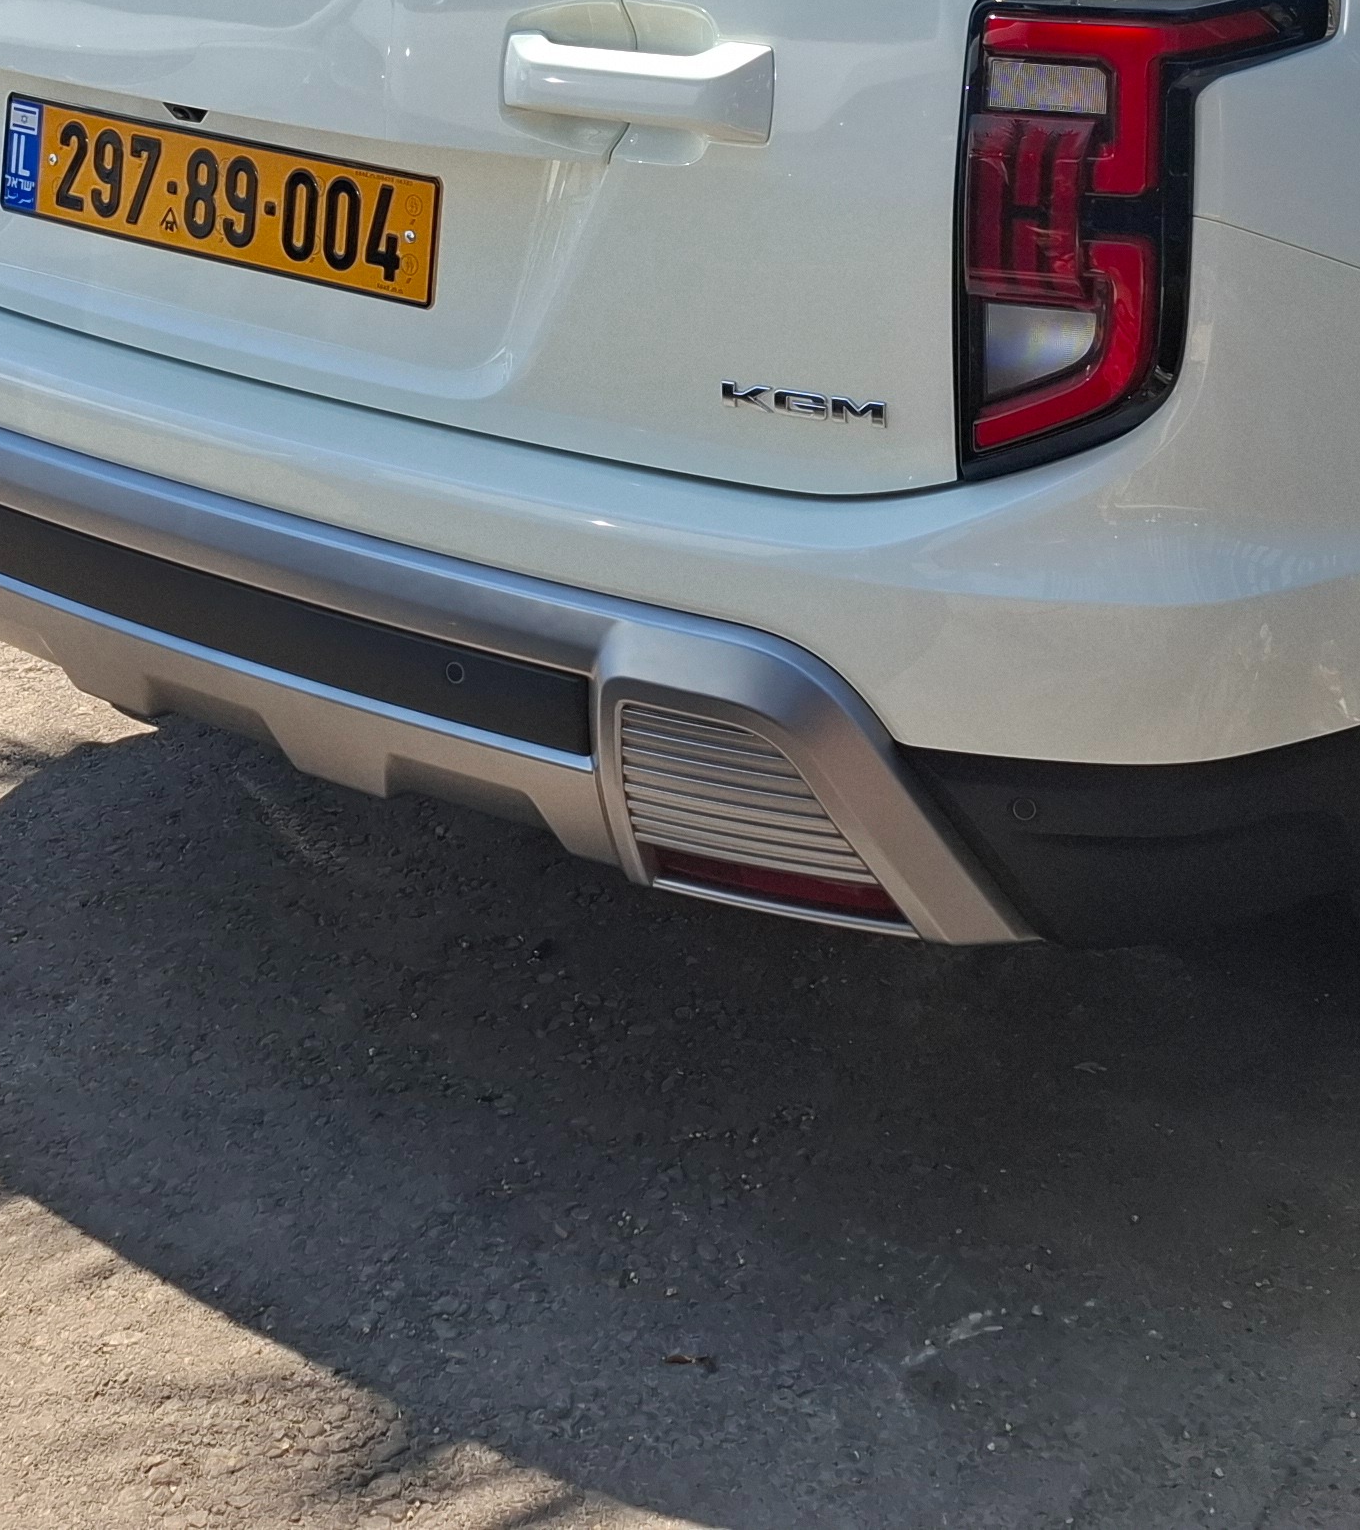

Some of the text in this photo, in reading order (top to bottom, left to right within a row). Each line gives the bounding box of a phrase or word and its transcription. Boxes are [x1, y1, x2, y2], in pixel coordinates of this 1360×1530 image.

[10, 132, 31, 177] IL
[4, 174, 35, 192] ישראל
[721, 379, 887, 429] KGM
